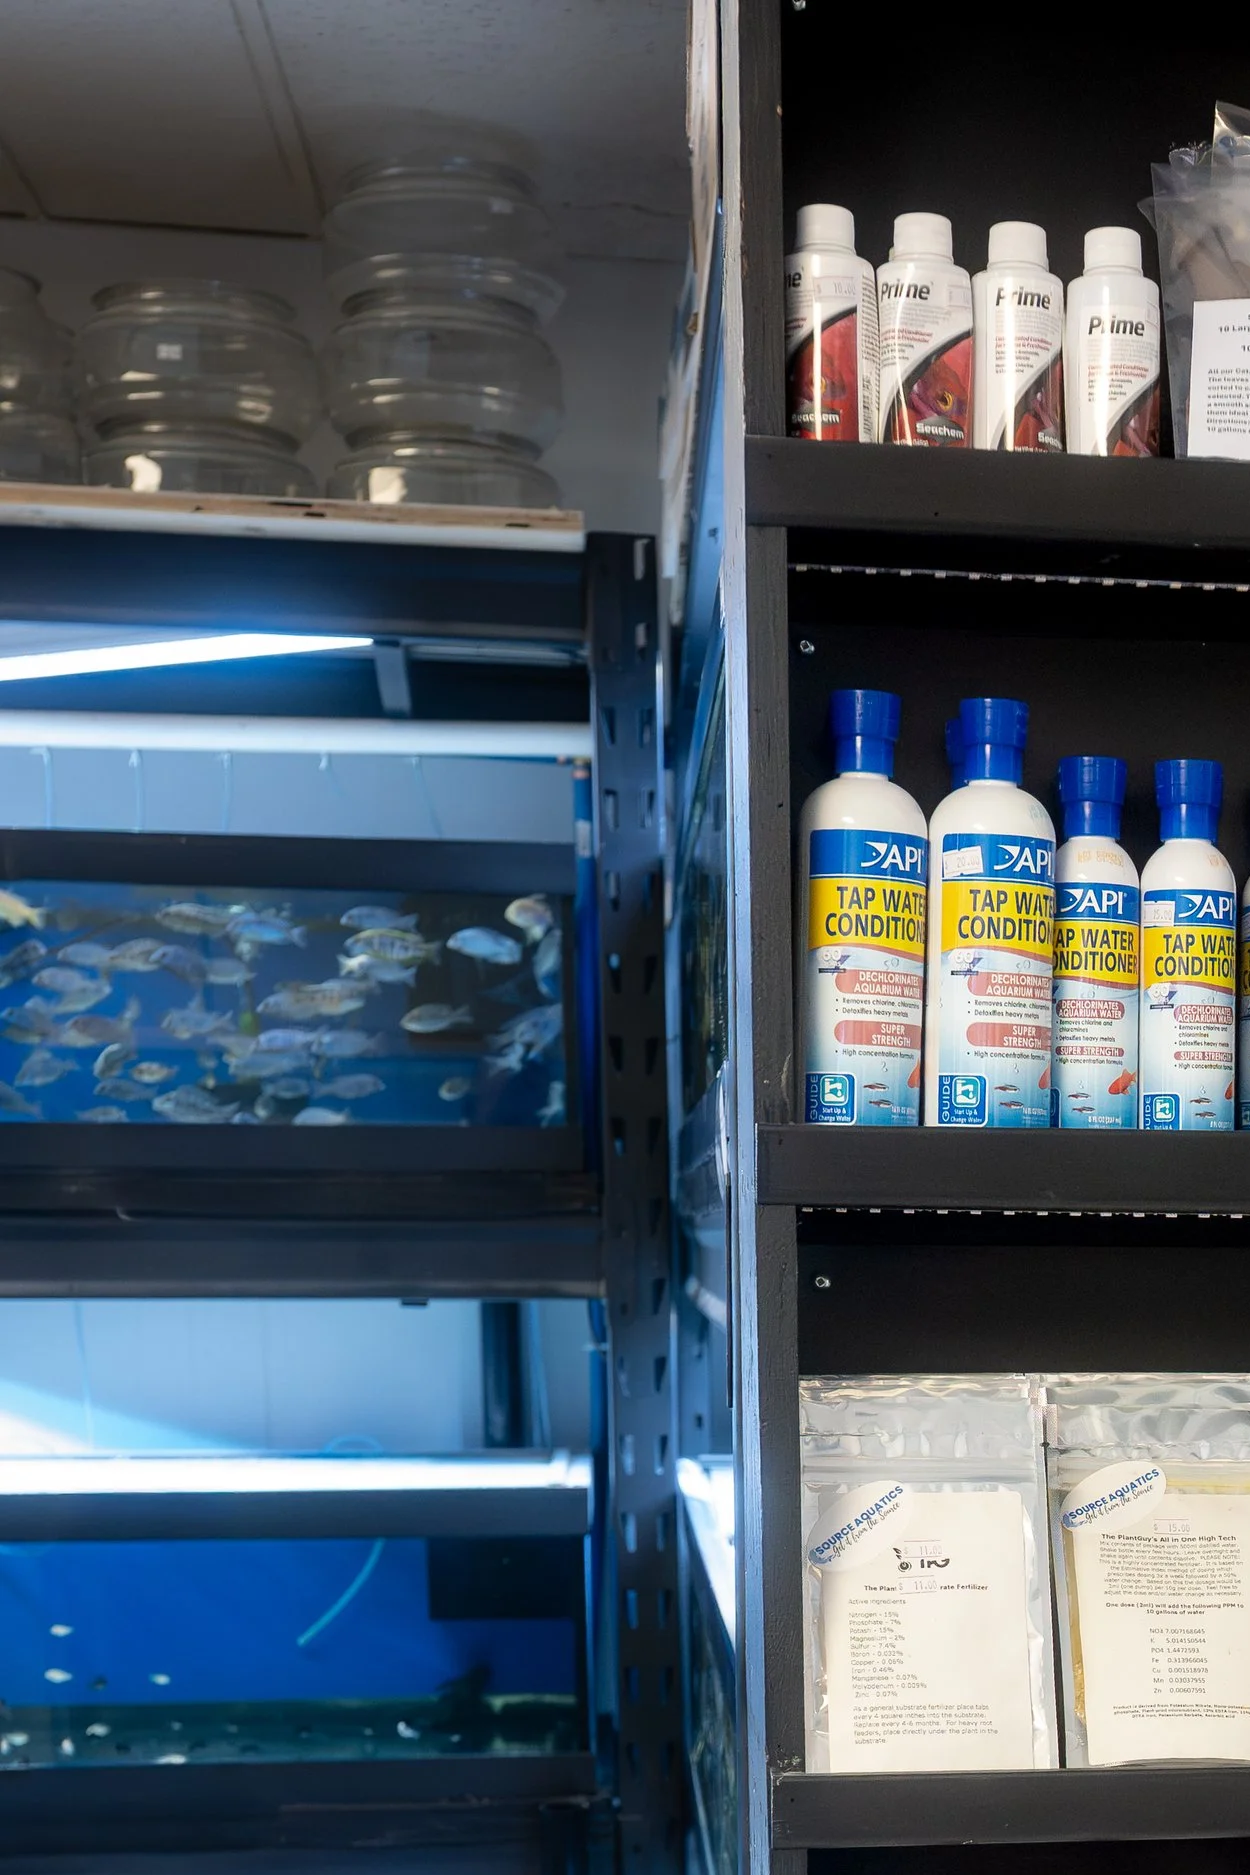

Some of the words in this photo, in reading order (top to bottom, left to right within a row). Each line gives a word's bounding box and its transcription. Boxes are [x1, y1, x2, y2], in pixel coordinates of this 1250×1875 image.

[916, 422, 964, 439] Seachem
[1218, 426, 1247, 435] gallons
[883, 849, 922, 873] API
[1011, 852, 1052, 874] API
[836, 886, 876, 910] TAP
[969, 889, 1008, 913] TAP
[1077, 892, 1123, 914] API
[1197, 897, 1233, 920] API
[1082, 930, 1134, 951] WATER
[1163, 934, 1192, 953] TAP
[854, 983, 902, 994] AQUARIUM
[1005, 1011, 1023, 1019] heavy
[1059, 1009, 1096, 1018] AQUARIUM
[1099, 1010, 1122, 1019] WATER
[1062, 1001, 1119, 1011] DECHLORINATES
[881, 1024, 905, 1034] SUPER
[872, 1035, 911, 1046] STRENGTH
[1060, 1047, 1079, 1056] SUPER
[1081, 1047, 1119, 1057] STRENGTH
[941, 1076, 950, 1122] GUIDE
[1069, 1497, 1107, 1520] SOURCE
[1109, 1469, 1160, 1503] AQUATICS
[816, 1523, 856, 1556] SOURCE
[854, 1485, 903, 1530] AQUATICS
[1118, 1534, 1158, 1542] PlantGuy's
[957, 1583, 988, 1591] Fertilizer
